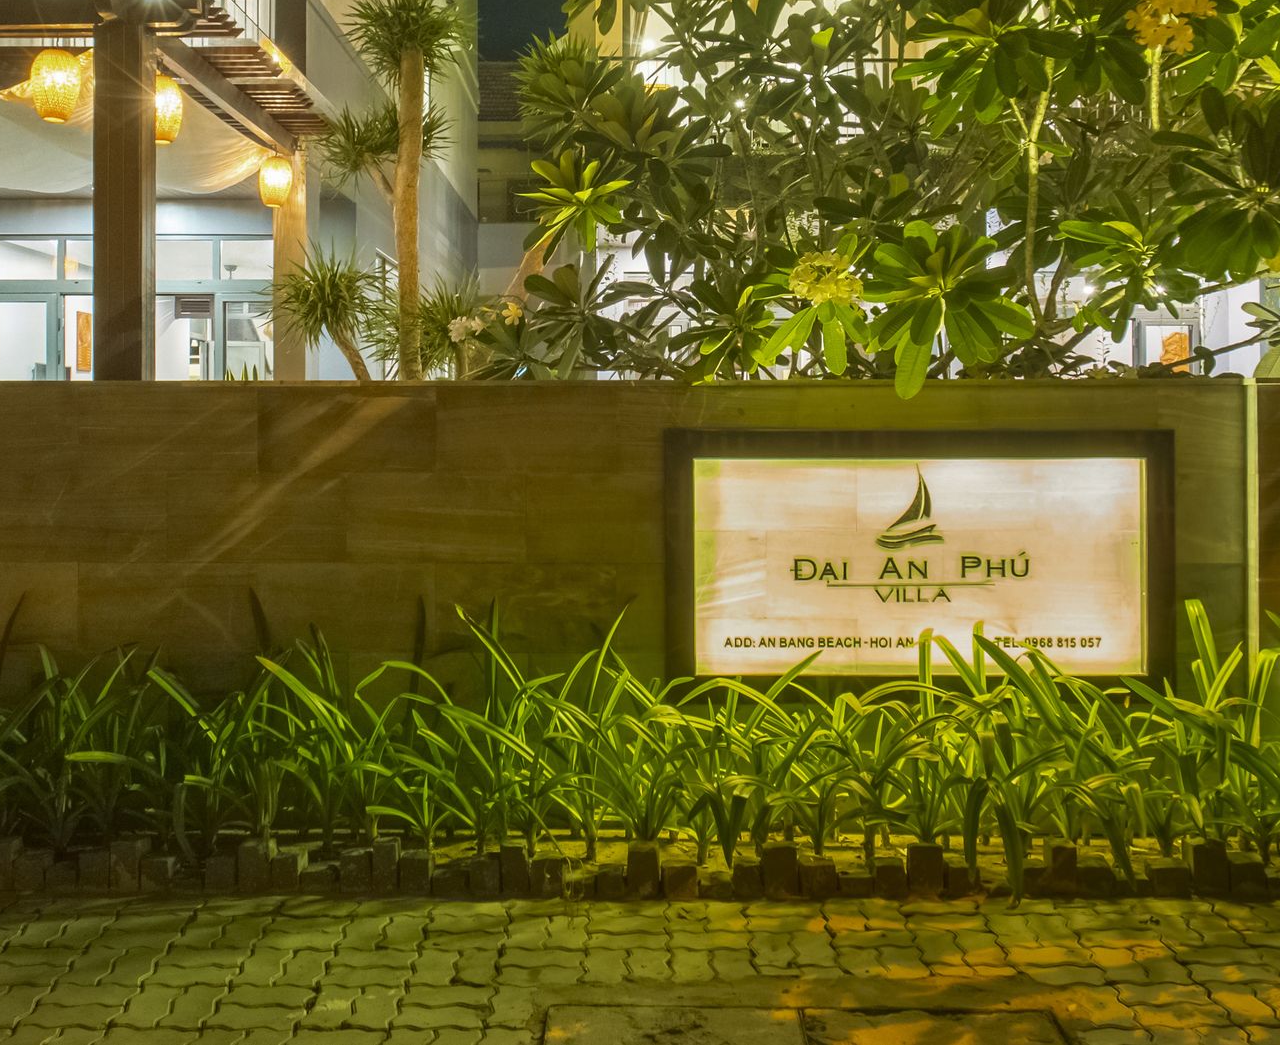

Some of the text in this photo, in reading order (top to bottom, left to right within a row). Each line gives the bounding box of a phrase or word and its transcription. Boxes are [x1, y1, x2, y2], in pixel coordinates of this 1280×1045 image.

[878, 557, 929, 580] AN
[960, 551, 1031, 578] PHÚ
[874, 587, 952, 603] VILLA
[723, 637, 756, 649] ADD:
[758, 637, 776, 649] AN
[779, 637, 815, 649] BANG
[895, 637, 914, 649] AN
[1056, 637, 1077, 649] 815
[1080, 637, 1102, 649] 057
